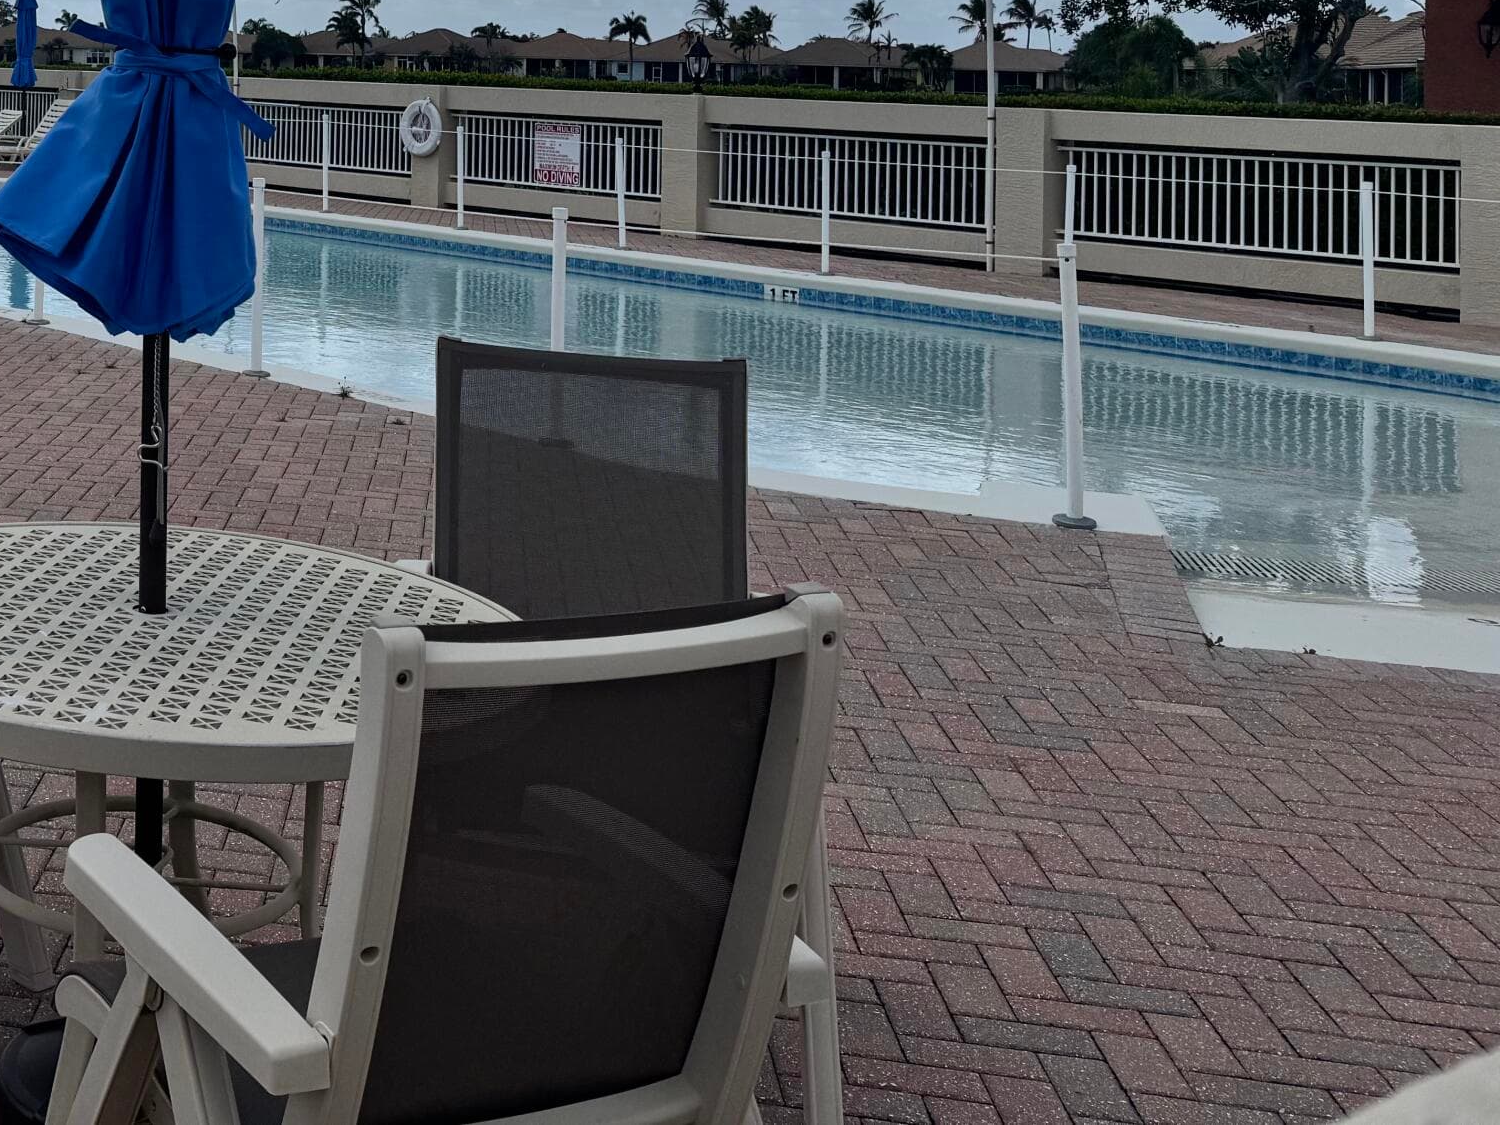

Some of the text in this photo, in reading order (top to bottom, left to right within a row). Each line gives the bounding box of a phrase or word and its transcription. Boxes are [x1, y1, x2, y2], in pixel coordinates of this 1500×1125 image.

[557, 126, 580, 134] RULES
[536, 170, 579, 185] NO DIVING
[782, 289, 797, 300] FT
